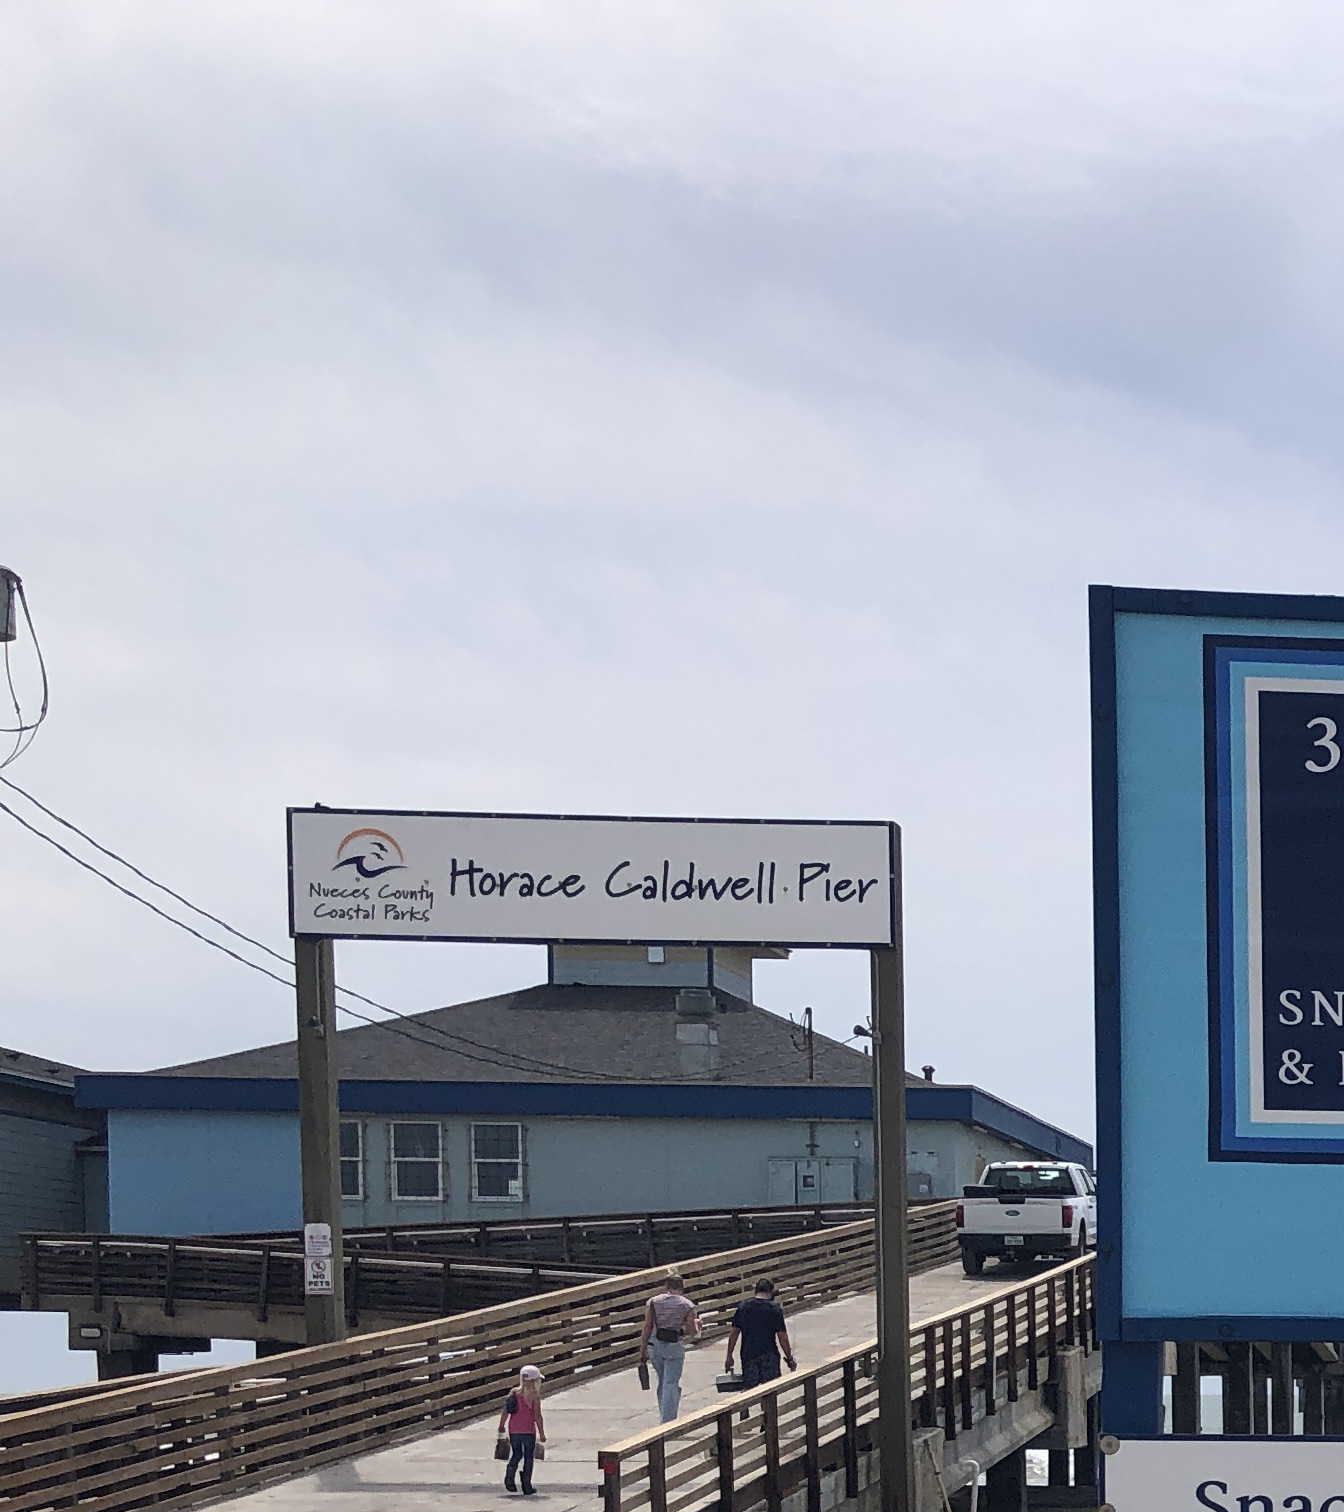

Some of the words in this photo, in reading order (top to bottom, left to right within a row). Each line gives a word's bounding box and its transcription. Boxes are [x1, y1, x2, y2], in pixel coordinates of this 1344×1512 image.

[309, 881, 371, 901] Nueces
[377, 883, 434, 910] County
[449, 858, 586, 898] Horace
[604, 859, 776, 904] Caldwell
[798, 862, 879, 904] Pier
[313, 902, 376, 921] Coastal
[384, 903, 431, 923] Parks
[1278, 1048, 1314, 1085] &
